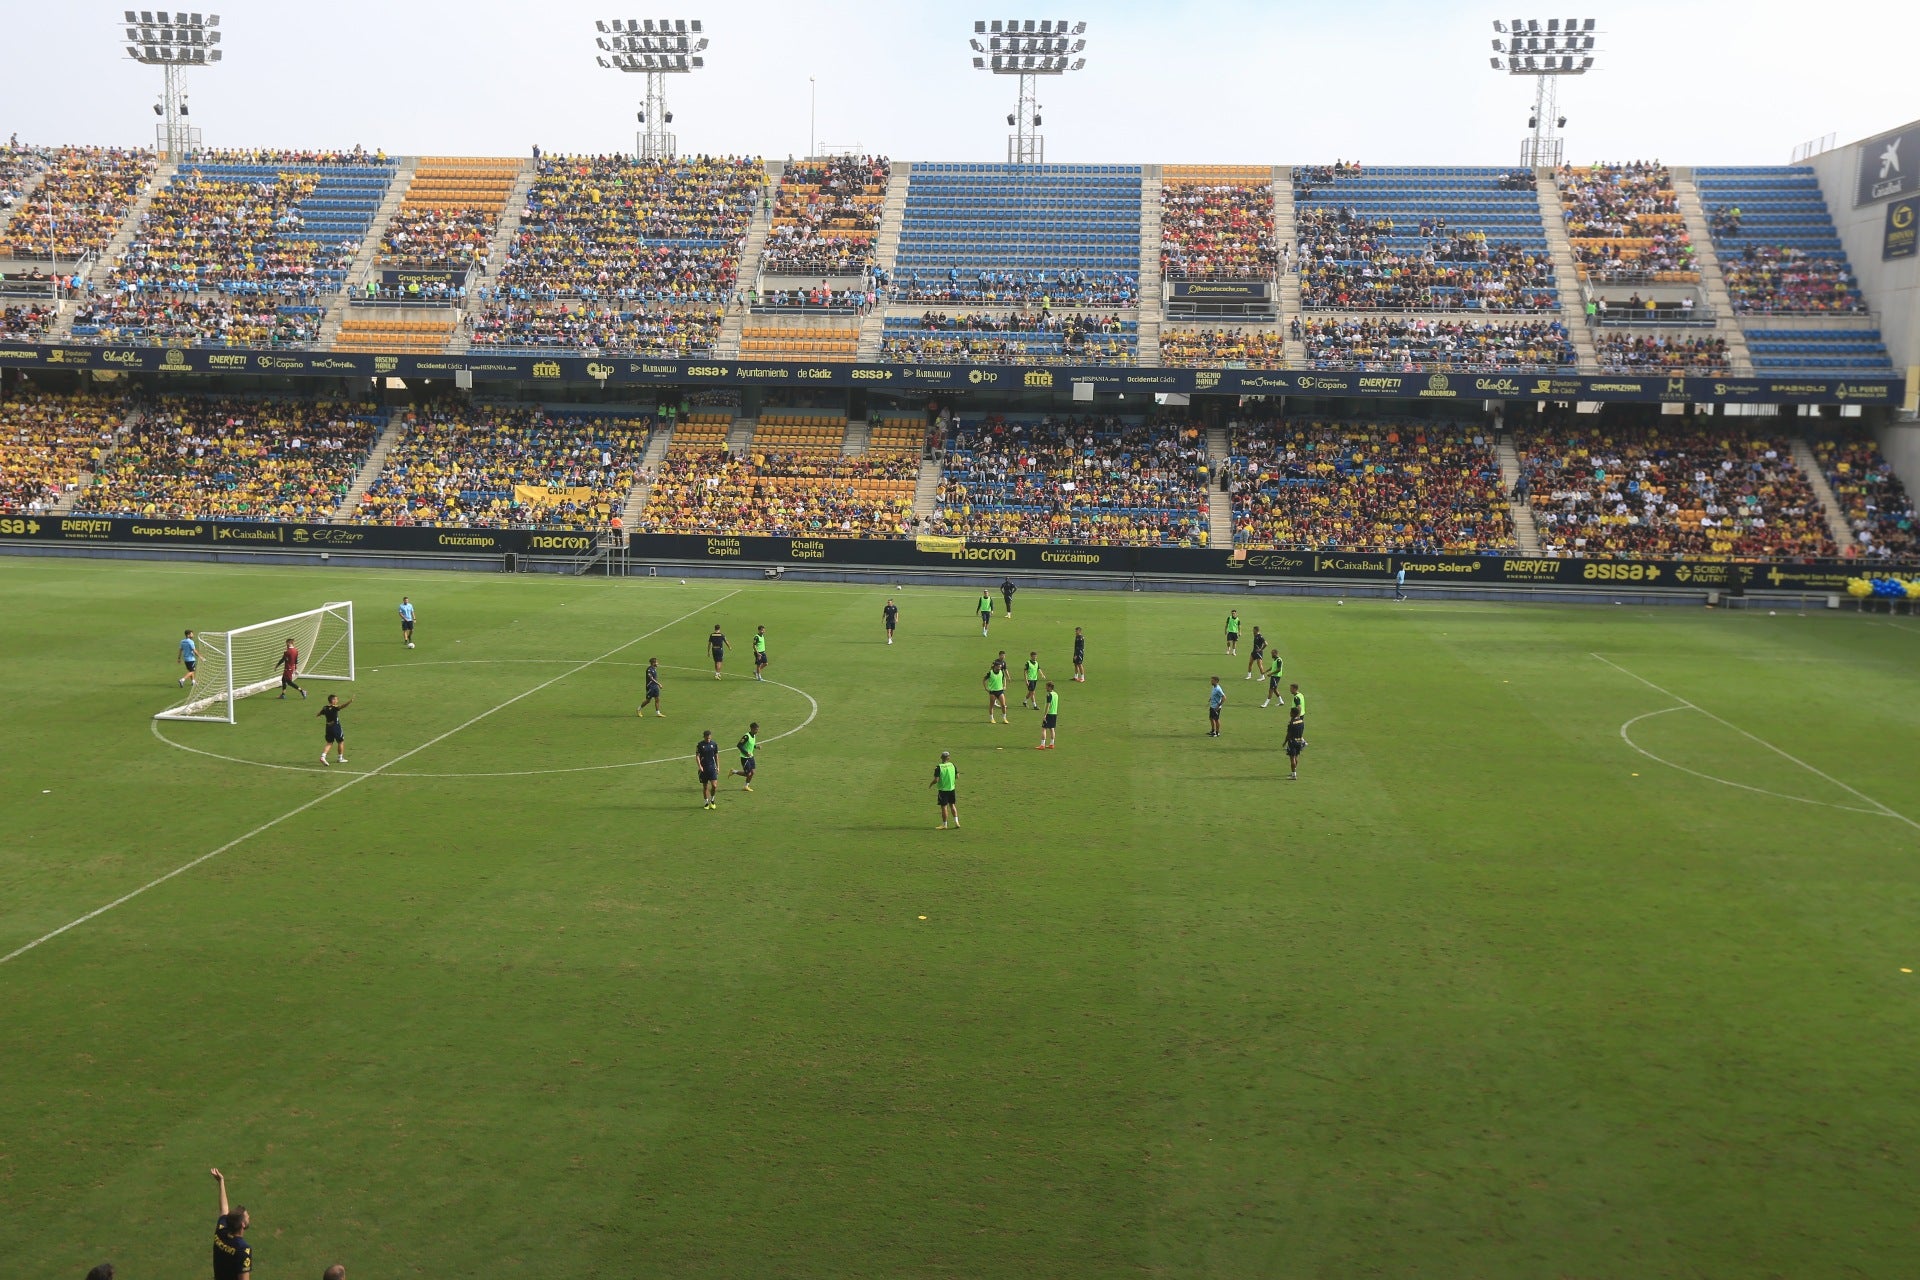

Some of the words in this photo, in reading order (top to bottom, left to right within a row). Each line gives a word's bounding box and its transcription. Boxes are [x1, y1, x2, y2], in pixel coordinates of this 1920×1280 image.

[398, 274, 421, 282] Grupo
[209, 354, 247, 366] ENERYETI
[276, 360, 304, 370] Copano
[532, 367, 560, 376] SLICE
[600, 364, 614, 375] bp
[642, 364, 677, 373] BARBADILLO
[688, 366, 718, 376] asisa
[736, 367, 788, 379] Ayuntamiento
[797, 368, 807, 378] de
[808, 368, 832, 378] Cádiz
[916, 368, 951, 378] BARBADILLO
[852, 369, 884, 380] asisa
[984, 370, 998, 381] bp
[1024, 376, 1053, 385] SLICE
[1318, 382, 1348, 390] Copano
[1359, 377, 1402, 388] ENERYETI
[62, 520, 112, 534] ENERYETI
[132, 526, 162, 536] Grupo
[232, 529, 277, 540] CaixaBank
[438, 534, 495, 547] Cruzcampo
[707, 537, 740, 547] Khalifa
[791, 540, 824, 550] Khalifa
[708, 546, 741, 556] Capital
[792, 549, 824, 559] Capital
[1041, 551, 1100, 564] Cruzcampo
[1336, 560, 1384, 571] CaixaBank
[1403, 562, 1436, 573] Grupo
[1504, 560, 1560, 574] ENERYETI
[1584, 564, 1644, 580] asisa
